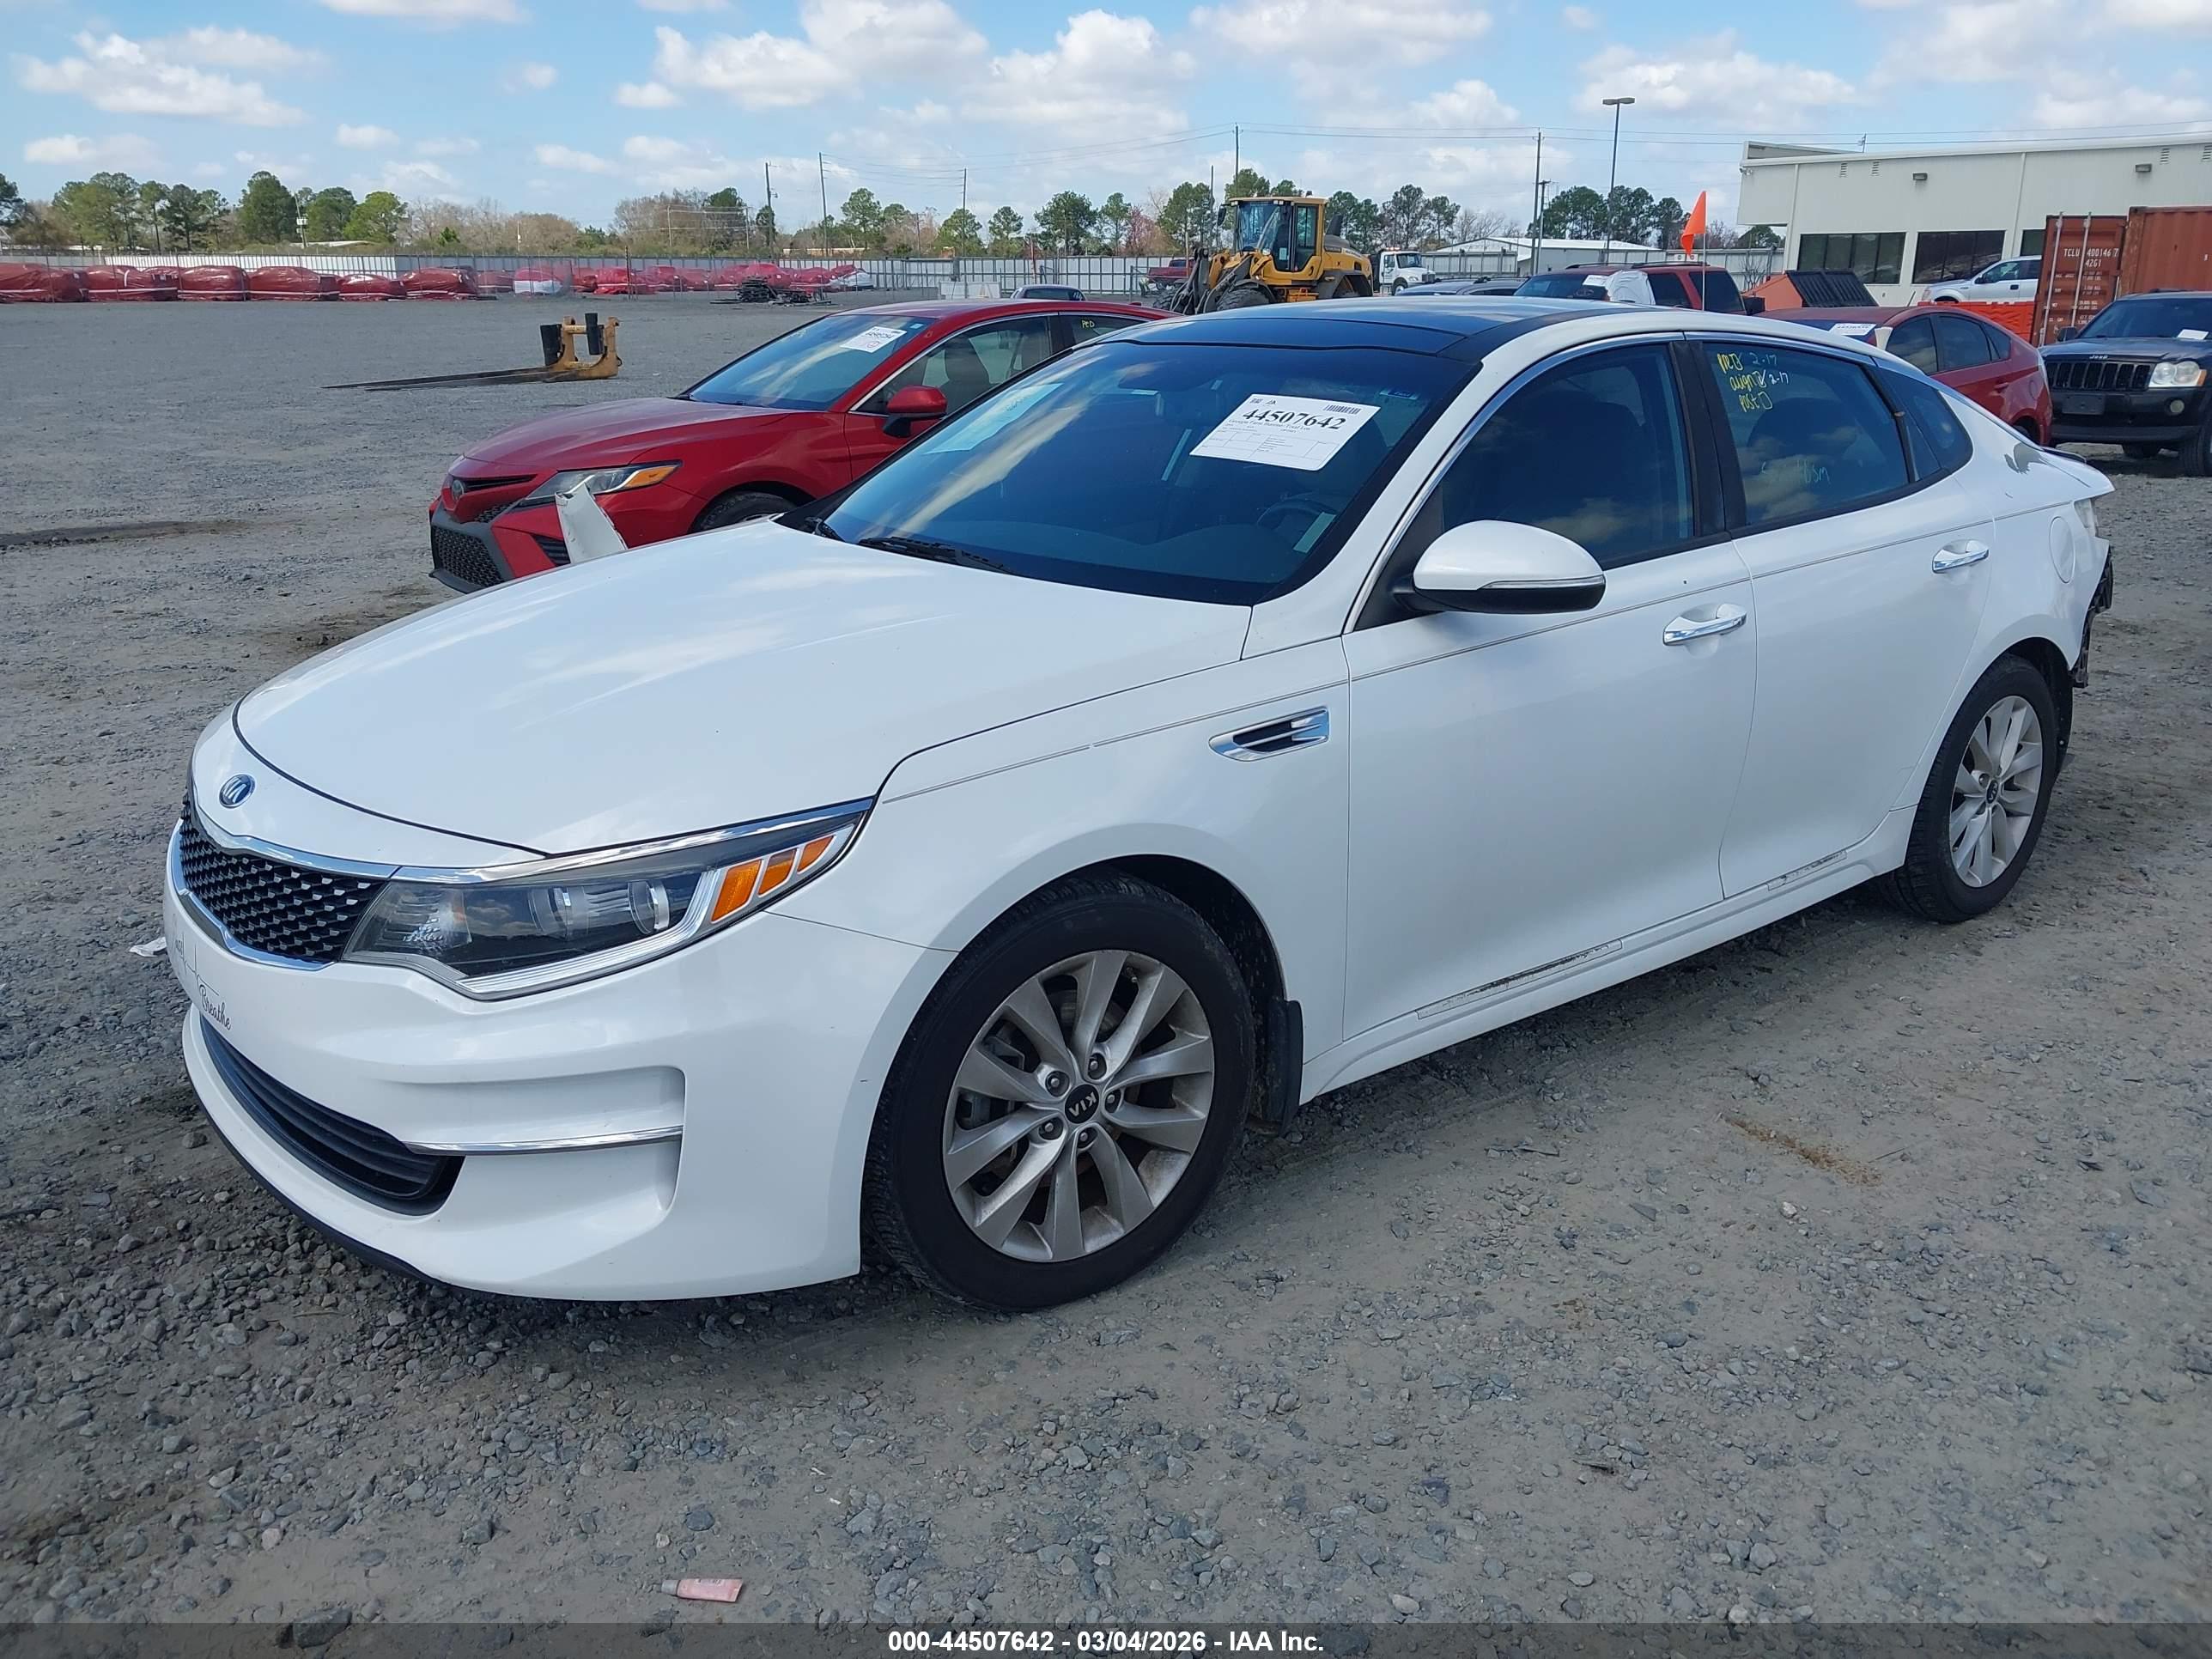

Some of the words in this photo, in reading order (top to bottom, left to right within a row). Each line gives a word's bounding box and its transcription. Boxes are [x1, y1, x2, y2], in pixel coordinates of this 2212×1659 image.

[2063, 248, 2081, 258] TCLU
[2087, 247, 2112, 258] 400146
[1243, 408, 1347, 431] 44507642
[198, 984, 232, 1031] Breathe
[1068, 1091, 1097, 1117] KIA
